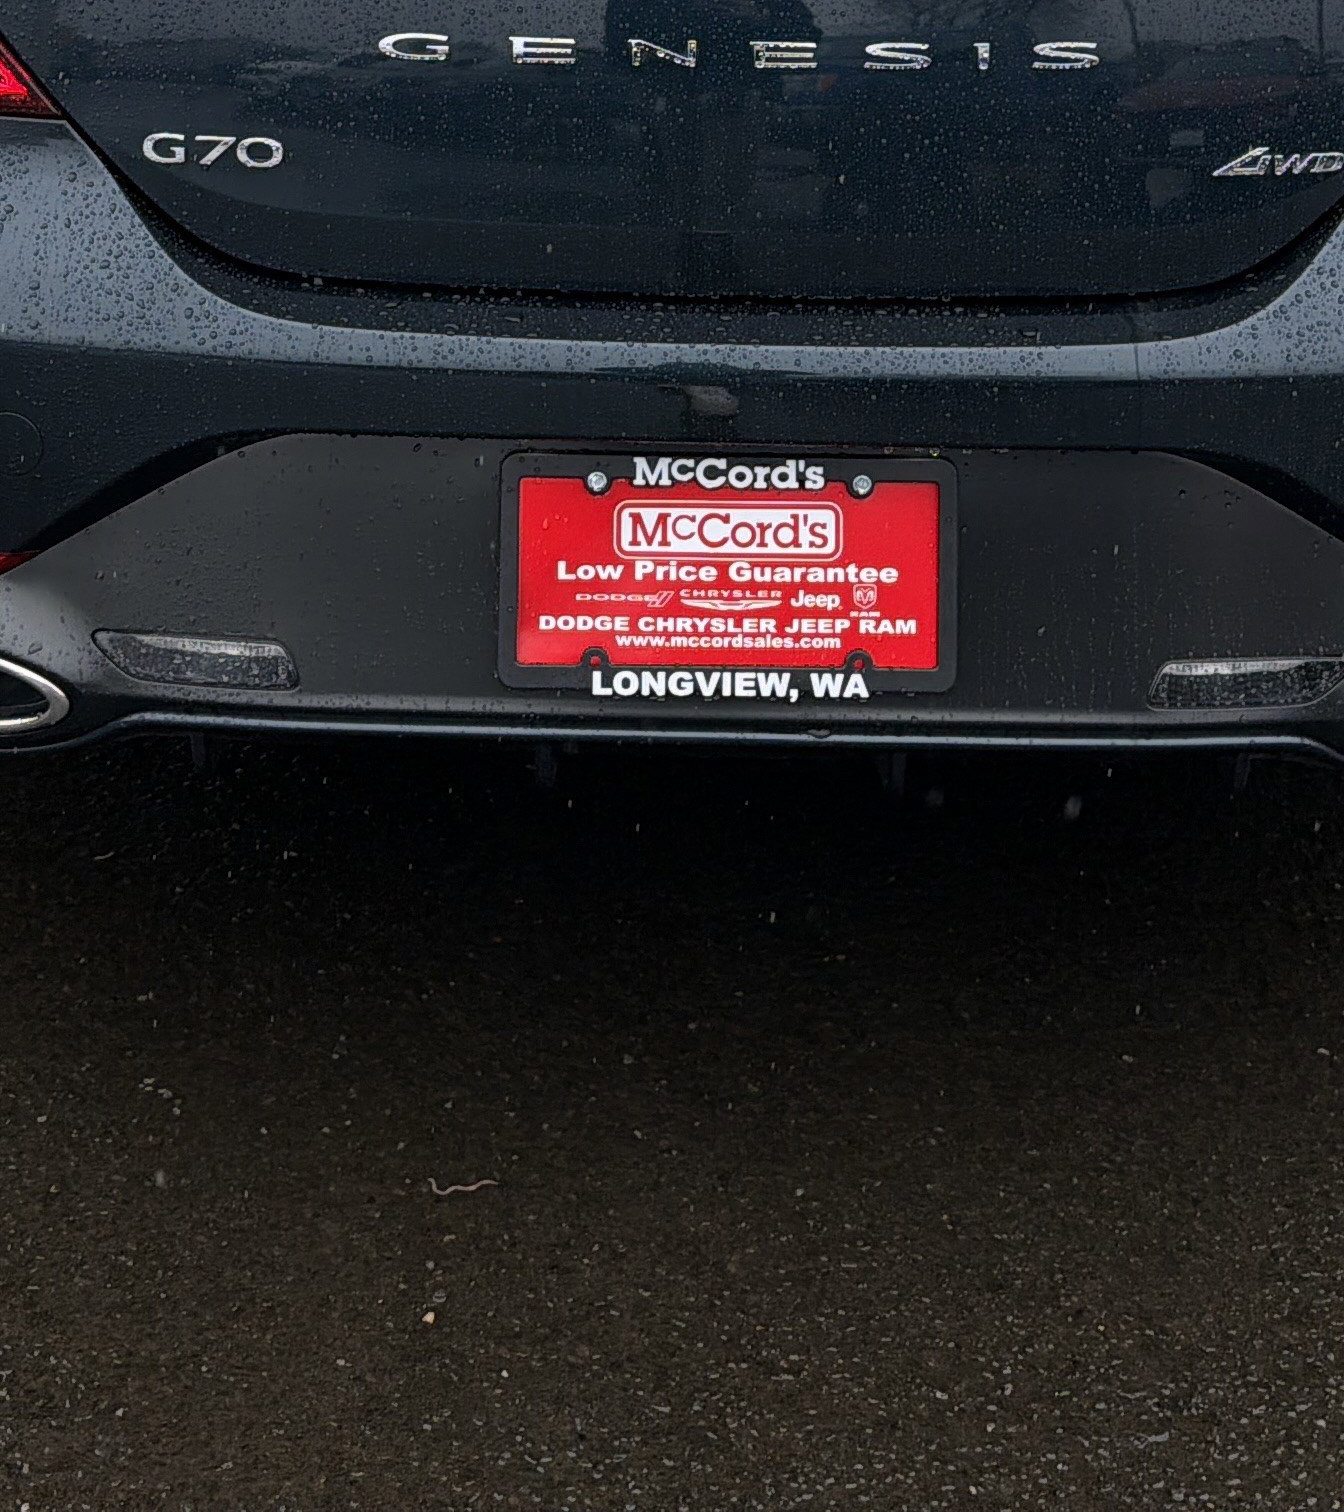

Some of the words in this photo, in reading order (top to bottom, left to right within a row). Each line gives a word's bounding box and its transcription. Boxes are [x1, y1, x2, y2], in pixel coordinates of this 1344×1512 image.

[377, 31, 1102, 72] GENESIS
[142, 130, 284, 168] G70
[1212, 146, 1344, 178] 4WD
[632, 457, 826, 489] McCord's
[628, 512, 829, 548] McCord's
[557, 561, 624, 581] Low
[635, 561, 718, 582] Price
[728, 562, 899, 584] Guarantee
[680, 589, 783, 599] CHRYSLER
[790, 589, 841, 611] Jeep
[539, 615, 631, 631] DODGE
[637, 617, 777, 633] CHRYSLER
[785, 618, 851, 634] JEEP
[859, 619, 917, 635] RAM
[615, 632, 842, 650] www.mccordsales.com
[592, 670, 799, 702] LONGVIEW,
[810, 673, 870, 699] WA
